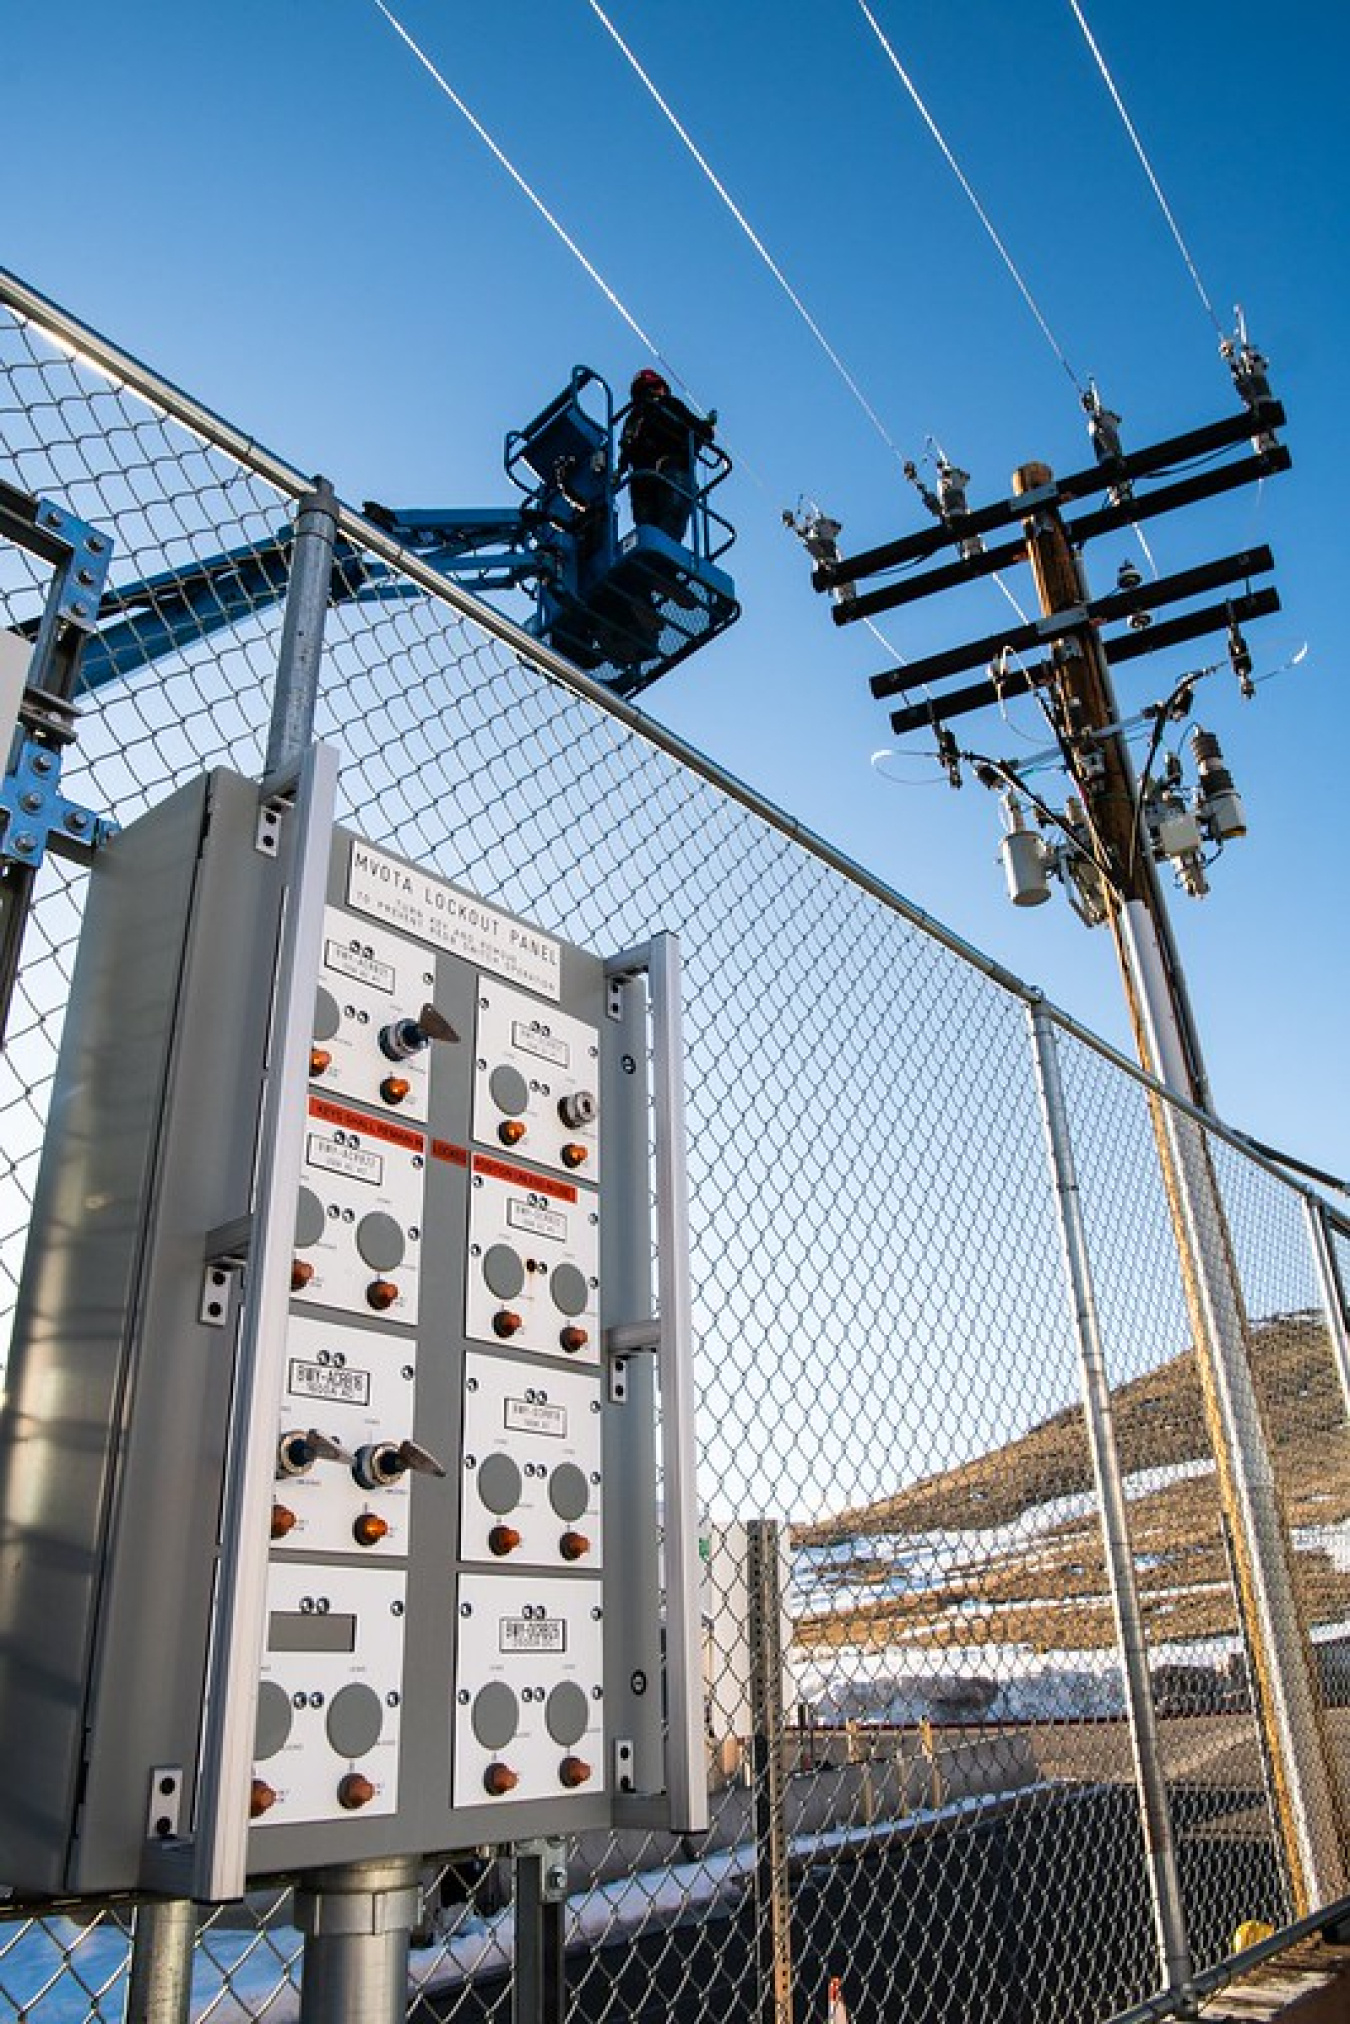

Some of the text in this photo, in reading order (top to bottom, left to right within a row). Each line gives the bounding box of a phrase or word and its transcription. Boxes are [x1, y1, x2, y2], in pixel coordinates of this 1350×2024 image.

[355, 852, 557, 966] MVOTA LOCKOUT PANEL
